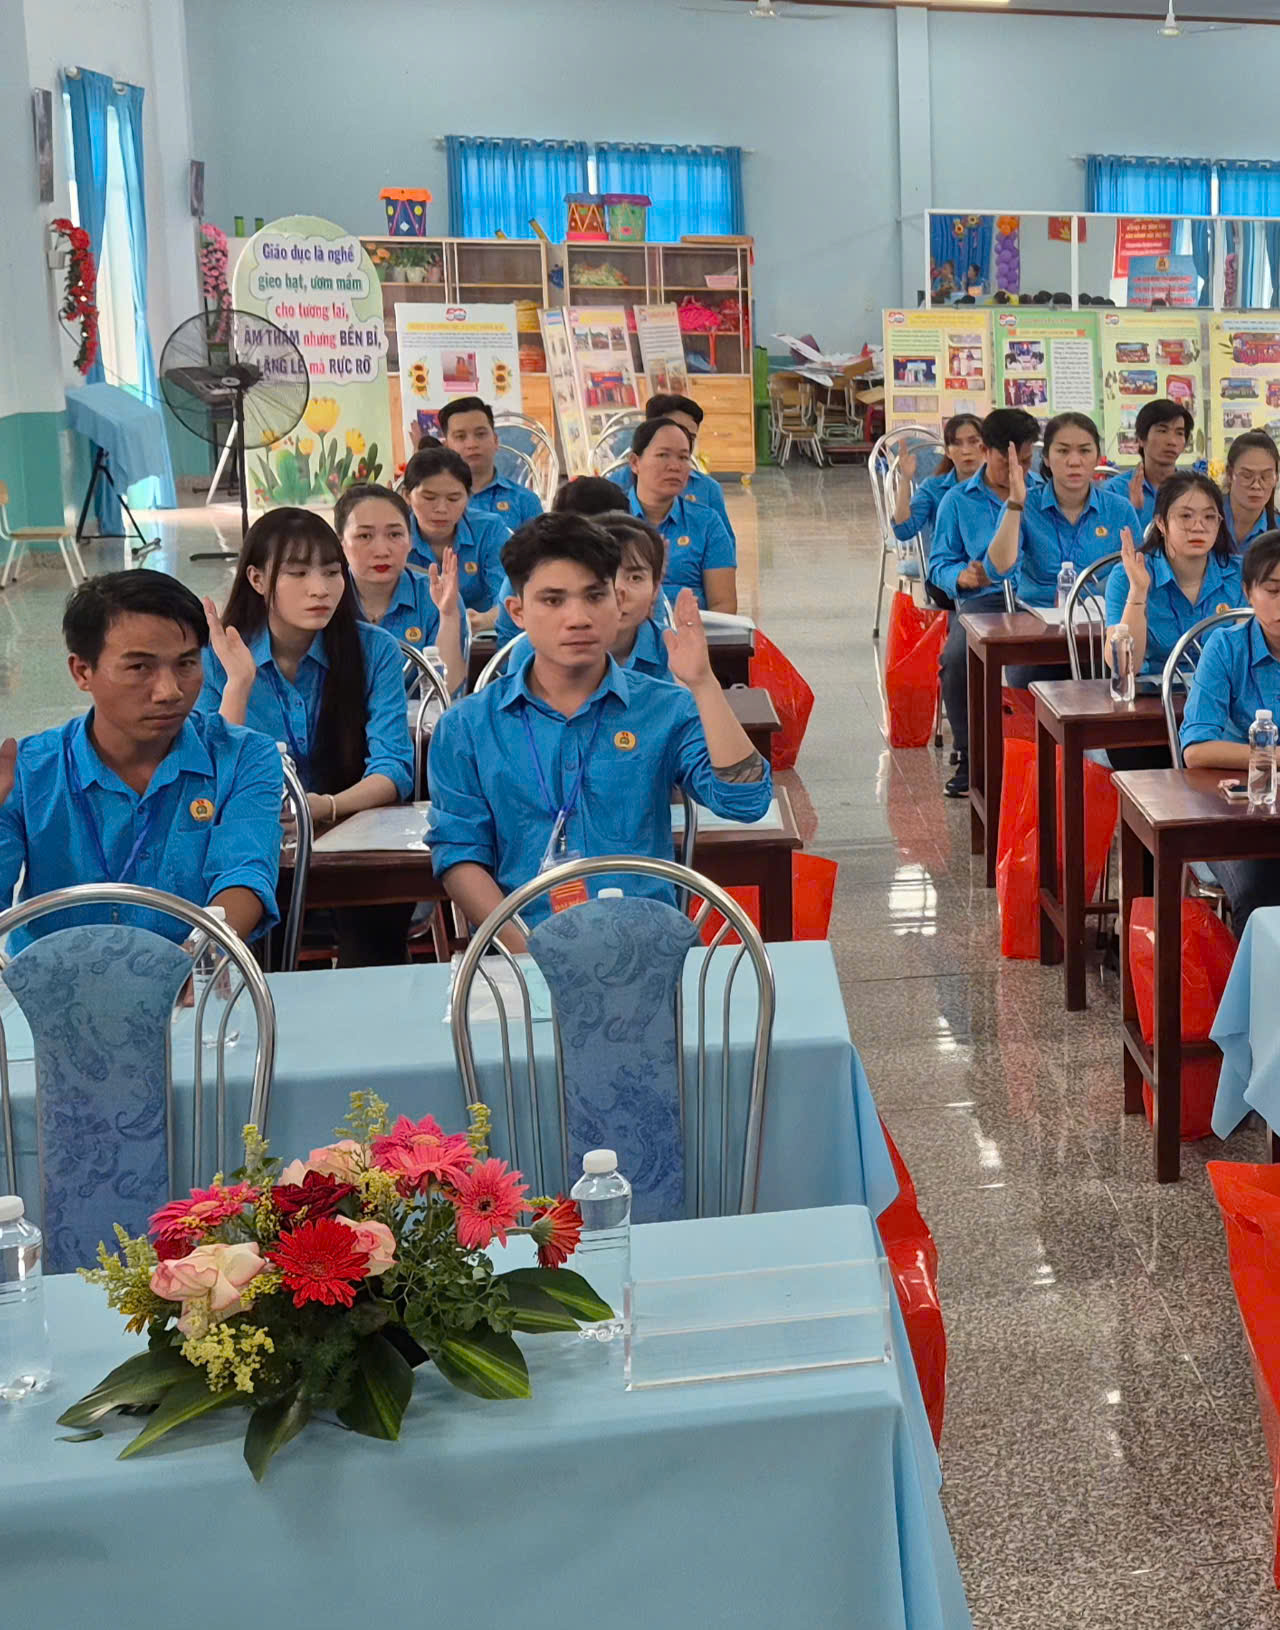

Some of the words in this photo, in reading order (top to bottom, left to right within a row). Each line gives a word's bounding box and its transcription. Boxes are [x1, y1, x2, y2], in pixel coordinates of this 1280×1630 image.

[262, 242, 287, 260] Giáo
[291, 244, 311, 264] dục
[314, 245, 325, 260] là
[328, 243, 355, 265] nghề
[258, 272, 282, 291] gieo
[275, 302, 294, 318] cho
[298, 303, 329, 321] tương
[303, 331, 337, 349] nhưng
[340, 323, 363, 346] BỀN
[309, 359, 325, 375] mà
[329, 355, 353, 378] RỰC
